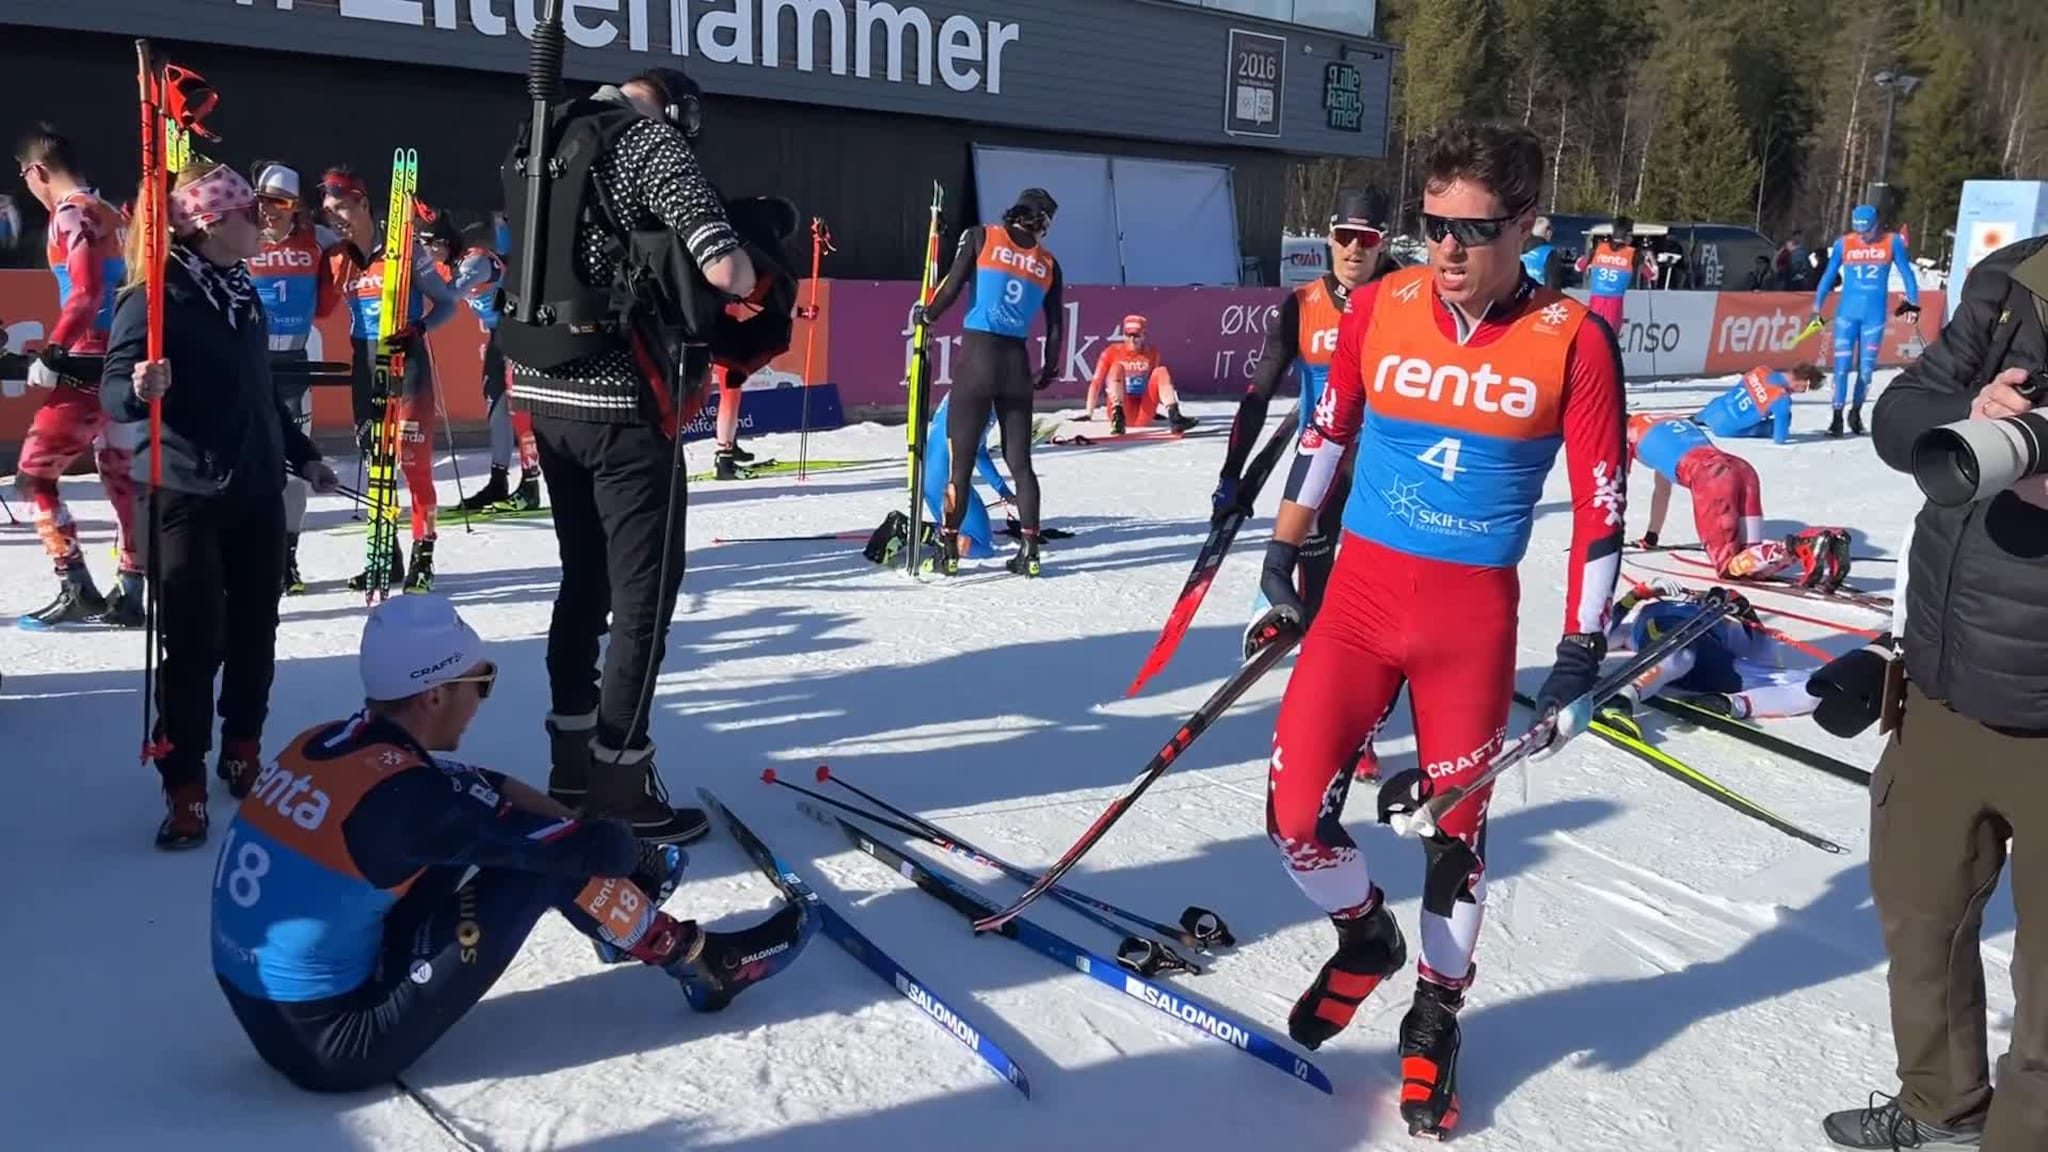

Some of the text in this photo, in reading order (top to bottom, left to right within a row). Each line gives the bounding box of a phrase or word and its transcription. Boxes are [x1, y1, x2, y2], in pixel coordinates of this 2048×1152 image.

[341, 0, 1019, 94] eammer
[1238, 52, 1276, 80] 2016
[1329, 66, 1360, 92] Lille
[389, 168, 402, 242] FISCHER
[251, 247, 312, 267] enta
[991, 245, 1046, 278] renta
[1596, 253, 1627, 266] renta
[1701, 244, 1718, 265] FA
[1847, 247, 1886, 260] renta
[1598, 268, 1618, 282] 35
[1705, 265, 1724, 285] BE
[1853, 264, 1880, 280] 12
[272, 280, 287, 302] 1
[1004, 280, 1023, 304] 9
[1718, 307, 1801, 353] renta
[1214, 351, 1235, 379] IT
[1374, 355, 1537, 418] renta
[1734, 387, 1752, 411] 15
[1416, 437, 1468, 482] 4
[410, 656, 455, 679] CRAFT
[1427, 738, 1495, 779] CRAFT
[252, 760, 331, 831] enta
[215, 828, 271, 908] 18
[610, 888, 639, 923] 18
[741, 941, 789, 965] SALOMON
[908, 982, 979, 1050] SALOMON
[1143, 983, 1249, 1050] SALOMON
